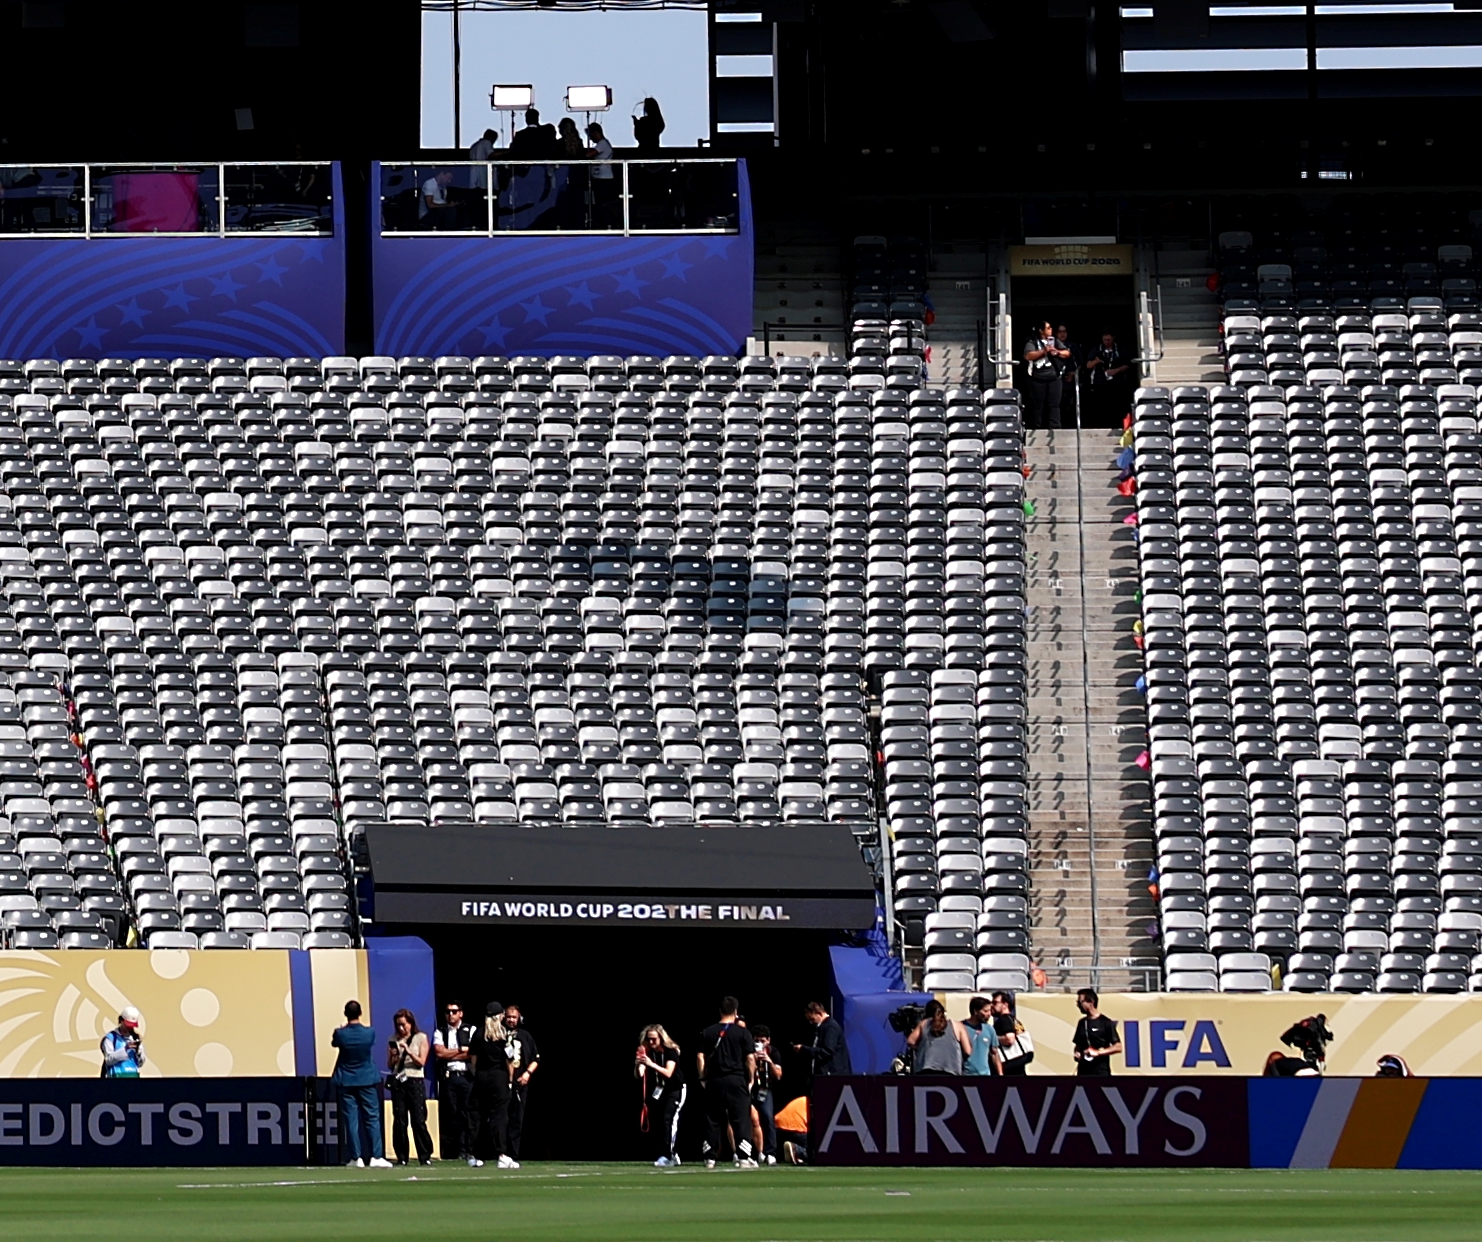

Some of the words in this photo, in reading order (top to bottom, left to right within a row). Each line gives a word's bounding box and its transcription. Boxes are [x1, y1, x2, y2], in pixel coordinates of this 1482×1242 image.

[461, 901, 501, 916] FIFA
[504, 902, 573, 918] WORLD
[576, 903, 614, 918] CUP
[665, 904, 712, 920] THE
[718, 905, 790, 921] FINAL
[1113, 1020, 1232, 1068] IFA
[818, 1084, 1207, 1157] AIRWAYS
